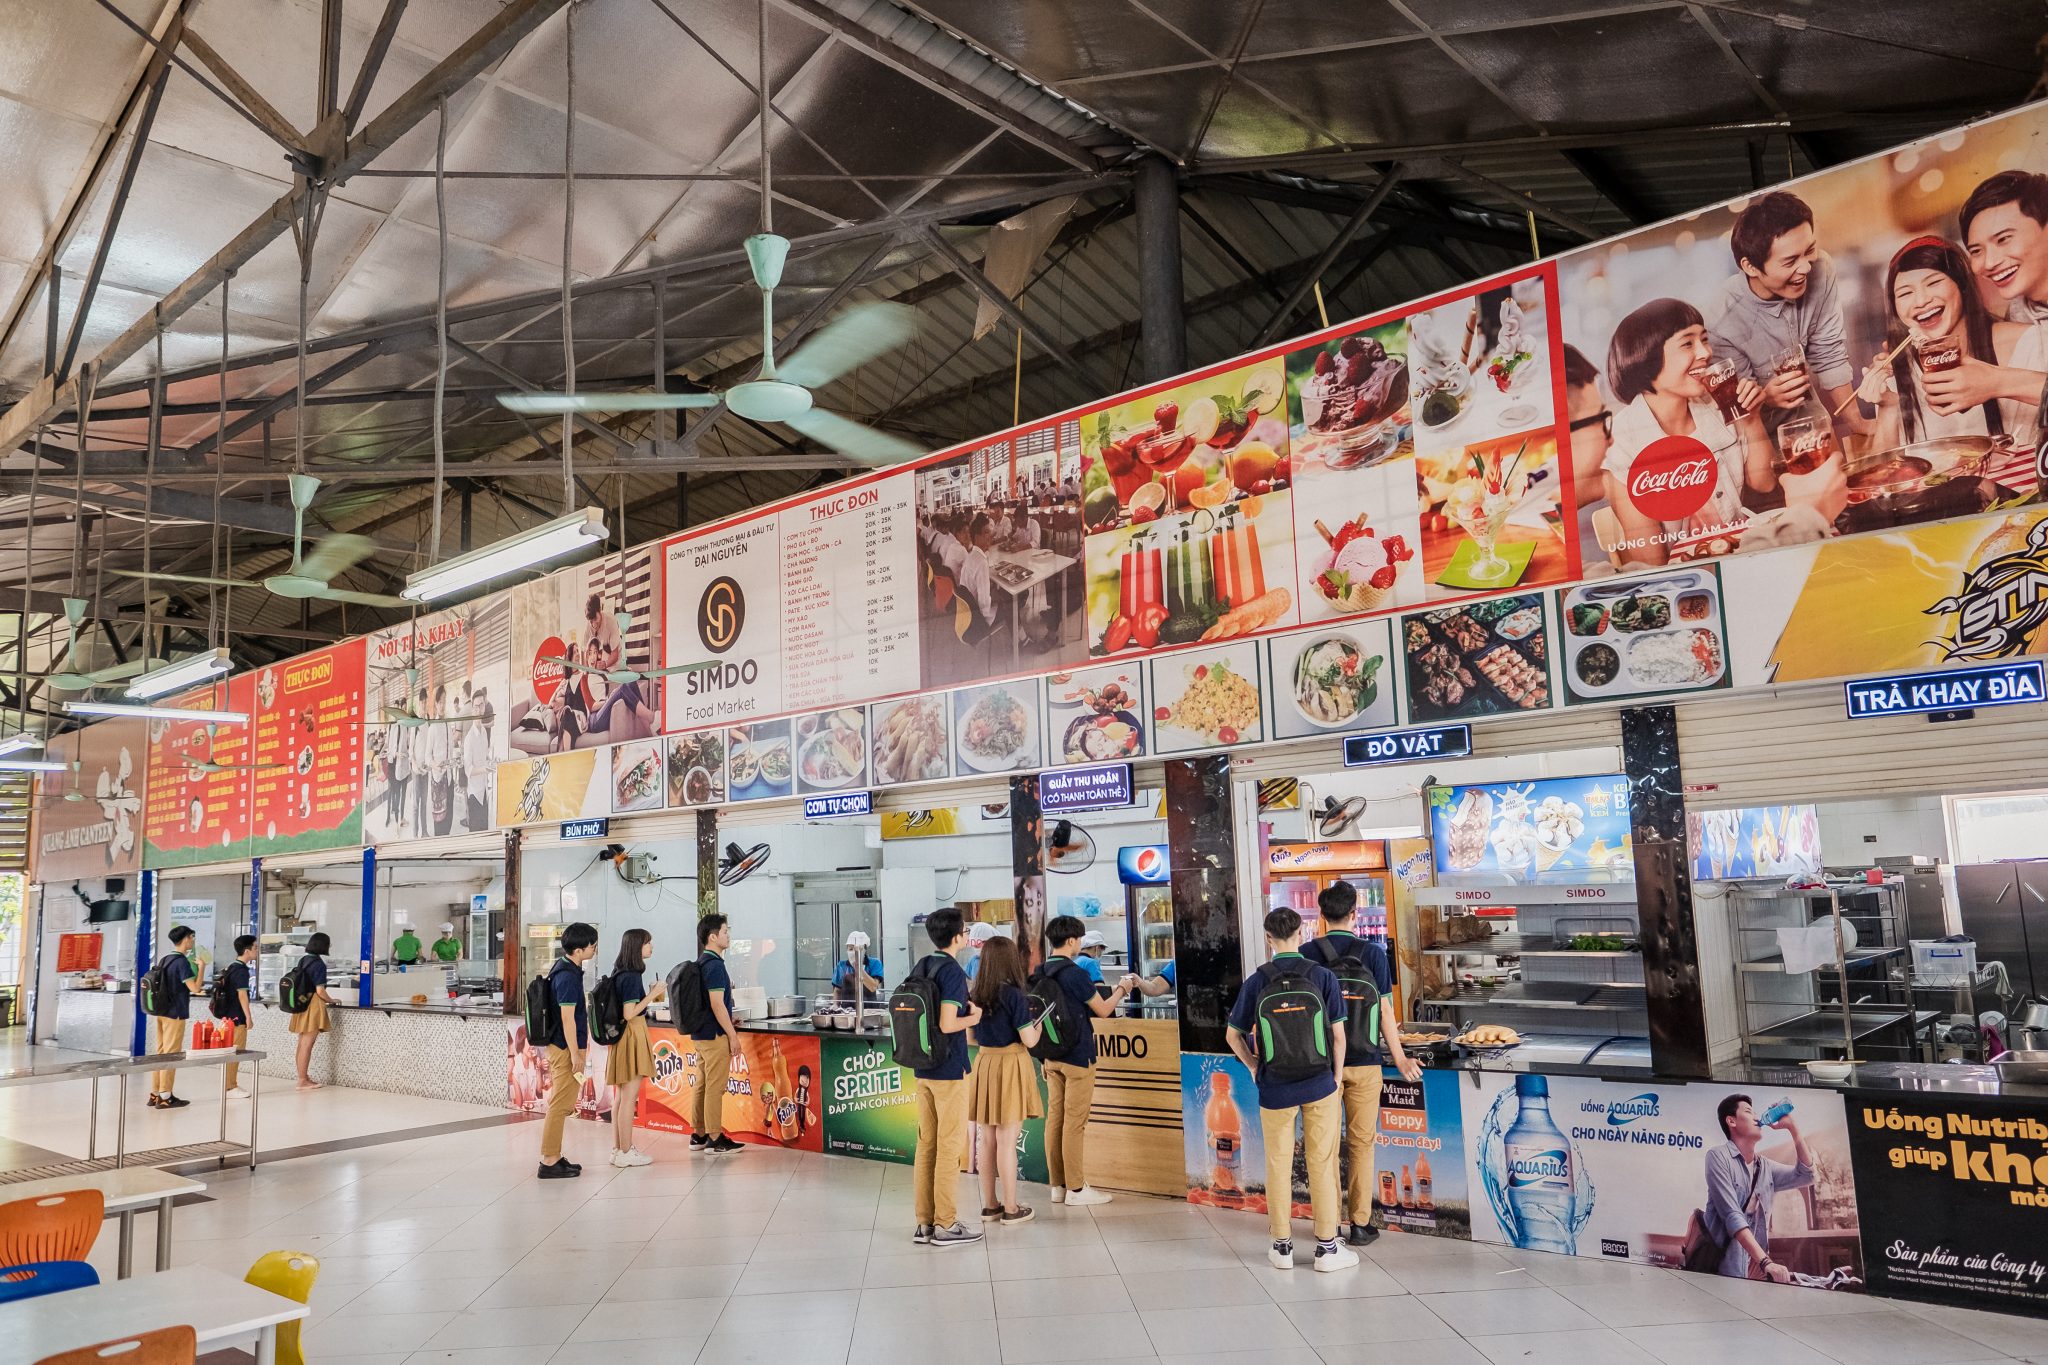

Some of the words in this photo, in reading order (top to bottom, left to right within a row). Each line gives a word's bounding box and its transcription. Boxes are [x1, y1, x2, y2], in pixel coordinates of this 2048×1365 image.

[1631, 457, 1712, 497] Coca-Cola
[694, 543, 709, 554] TNHH
[694, 554, 709, 568] ĐẠI
[428, 619, 464, 644] KHAY
[686, 658, 758, 695] SIMDO
[1853, 682, 1908, 712] TRẢ
[1911, 679, 1982, 707] KHAY
[1987, 671, 2037, 699] ĐĨA
[686, 703, 714, 720] Food
[717, 697, 755, 716] Market
[1074, 776, 1091, 787] THU
[1092, 771, 1119, 785] NGÂN
[1060, 791, 1085, 802] THANH
[1085, 788, 1108, 800] TOÁN
[806, 800, 826, 814] CƠM
[841, 796, 867, 812] CHỌN
[80, 821, 113, 846] CANTEEN
[565, 823, 581, 837] BÚN
[1396, 857, 1415, 880] Ngon
[1455, 891, 1491, 900] SIMDO
[1566, 888, 1606, 898] SIMDO
[1094, 1034, 1148, 1059] IMDO
[836, 1069, 899, 1098] SPRITE
[1383, 1084, 1420, 1096] Minute
[848, 1099, 867, 1112] TAN
[1388, 1094, 1415, 1105] Maid
[1580, 1099, 1605, 1113] UỐNG
[1383, 1111, 1423, 1130] Teppy
[1863, 1107, 1943, 1140] Uống
[1392, 1137, 1413, 1146] cam
[1571, 1127, 1595, 1140] CHO
[1598, 1127, 1629, 1142] NGÀY
[1631, 1128, 1665, 1145] NĂNG
[1668, 1131, 1703, 1150] ĐỘNG
[1888, 1145, 1947, 1171] giúp
[1885, 1239, 1918, 1262] Sản
[1917, 1246, 1959, 1269] phẩm
[1963, 1254, 1988, 1270] của
[1991, 1252, 2028, 1276] Công
[2028, 1260, 2047, 1283] ty
